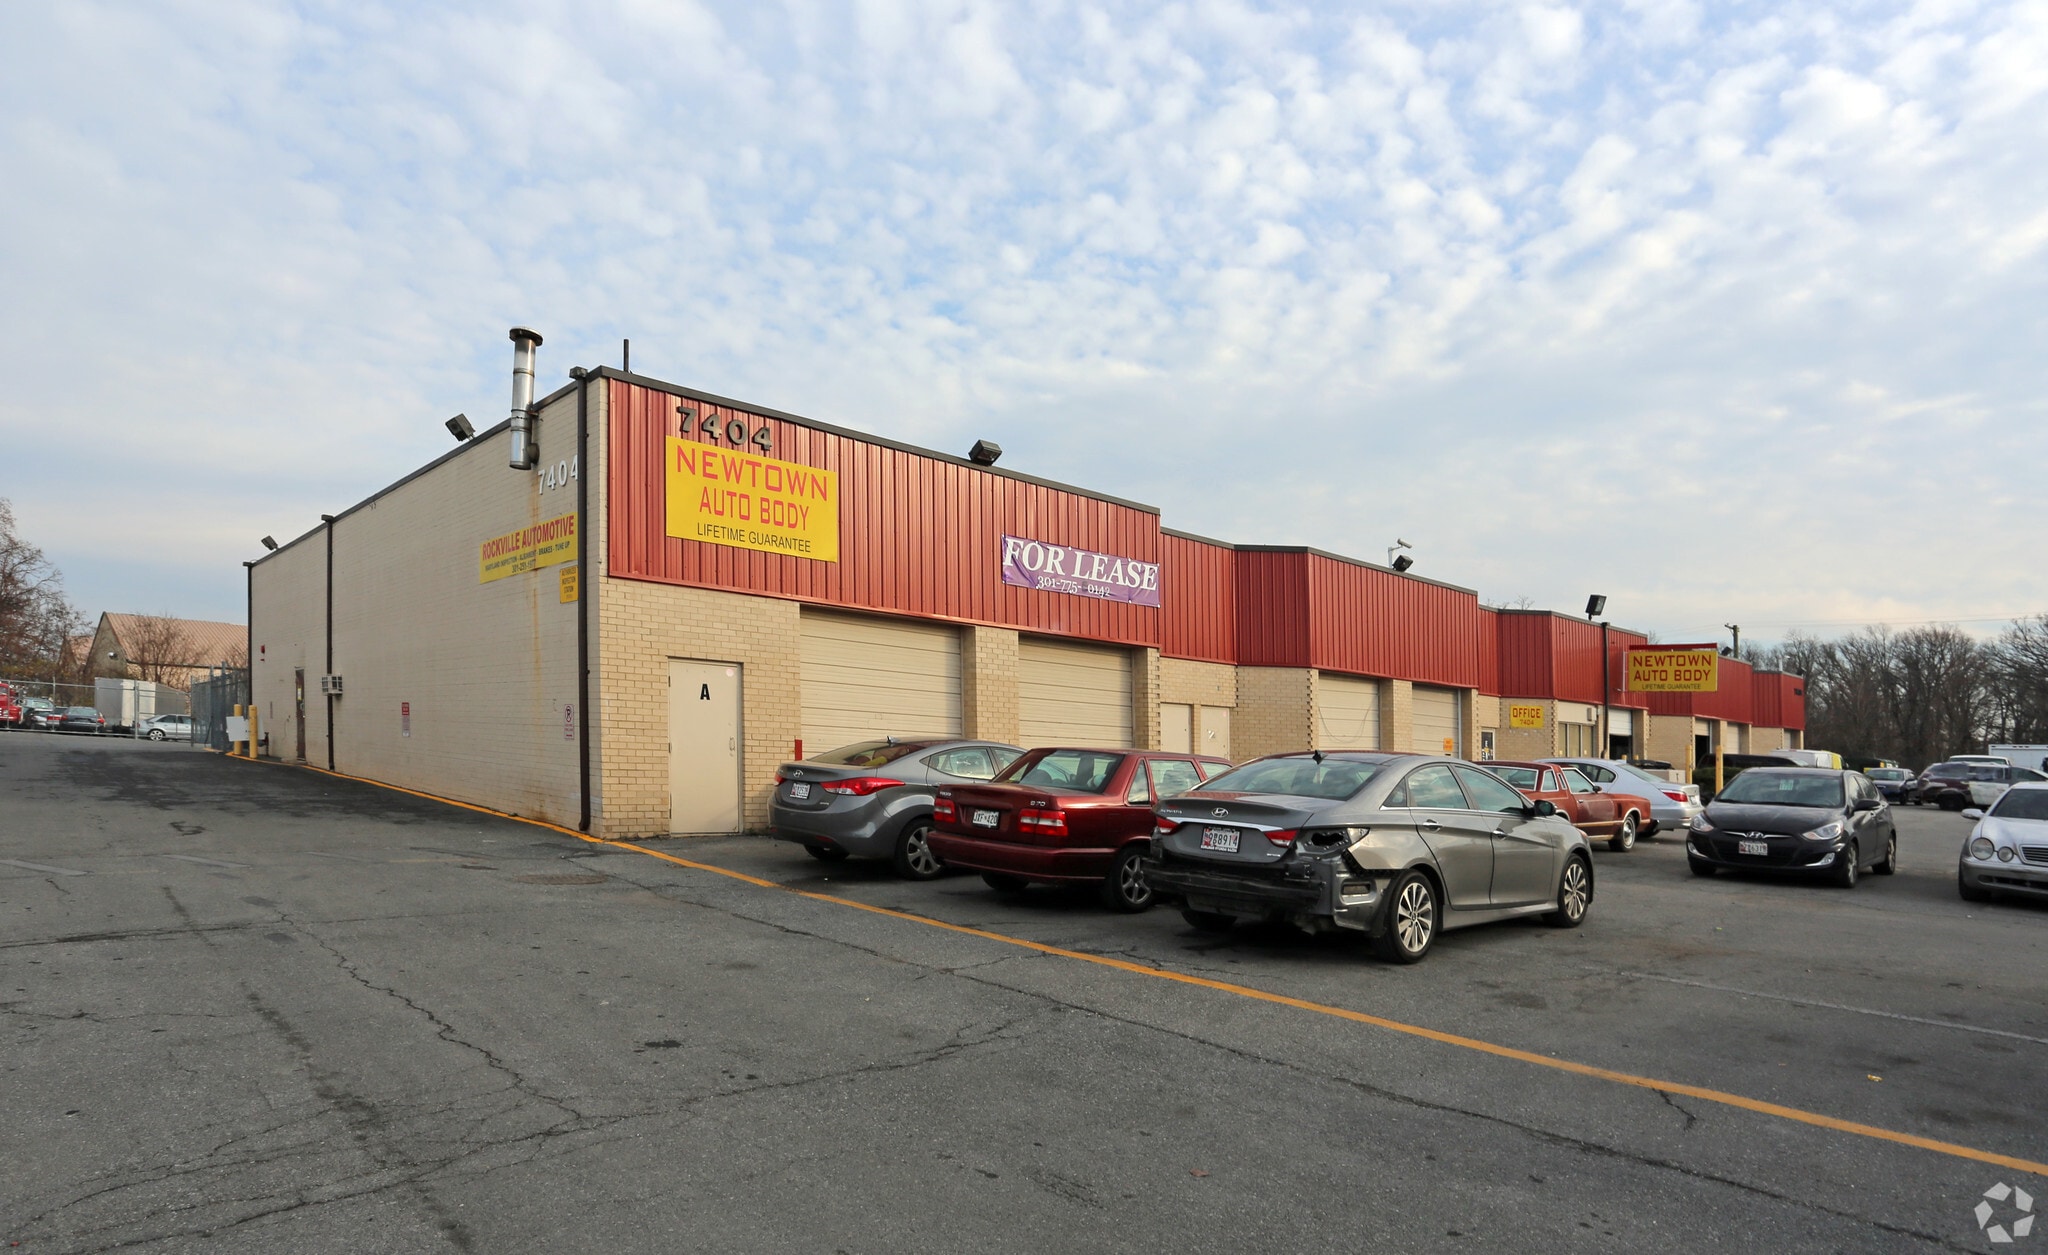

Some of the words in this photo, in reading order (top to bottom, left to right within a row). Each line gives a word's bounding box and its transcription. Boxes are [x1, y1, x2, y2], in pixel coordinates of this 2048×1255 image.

[677, 406, 772, 451] 7404
[677, 445, 828, 502] NEWTOWN
[699, 486, 750, 521] AUTO
[760, 497, 810, 531] BODY
[482, 532, 520, 560] ROCKVILLE
[522, 515, 575, 548] AUTOMOTIVE
[538, 545, 553, 555] BRAKES
[697, 522, 745, 543] LIFETIME
[749, 531, 811, 554] GUARANTEE
[1003, 538, 1065, 575] FOR
[1071, 551, 1158, 590] LEASE
[1633, 655, 1711, 667] NEWTOWN
[1633, 669, 1668, 681] AUTO
[1674, 669, 1711, 681] BODY
[700, 683, 710, 700] A
[1512, 708, 1540, 718] OFFICE
